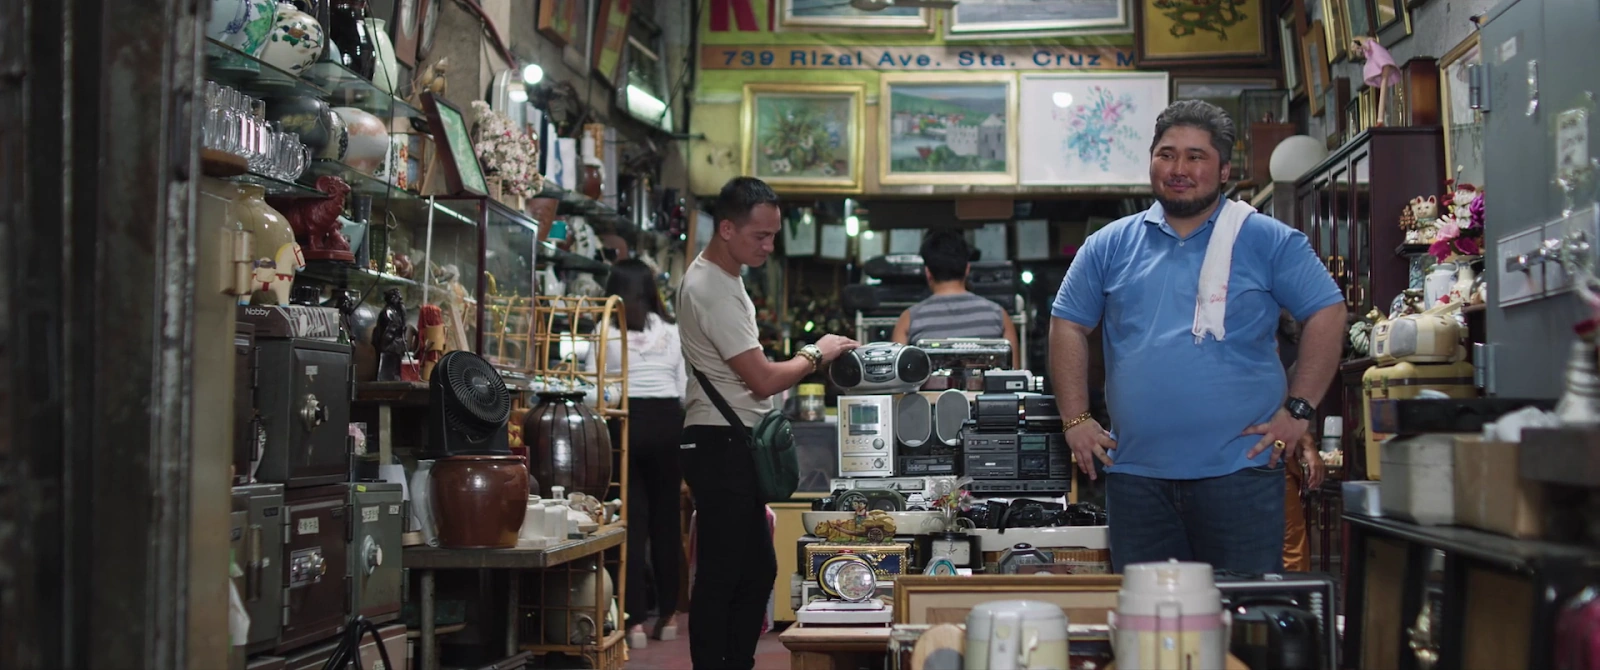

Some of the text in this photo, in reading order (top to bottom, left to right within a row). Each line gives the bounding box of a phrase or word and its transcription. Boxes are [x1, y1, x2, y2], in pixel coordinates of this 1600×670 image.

[723, 51, 774, 66] 739
[790, 51, 862, 66] Rizal
[878, 51, 941, 66] Ave.
[958, 50, 1016, 66] Sta.
[1033, 50, 1101, 66] Cruz
[245, 307, 270, 317] Nobby
